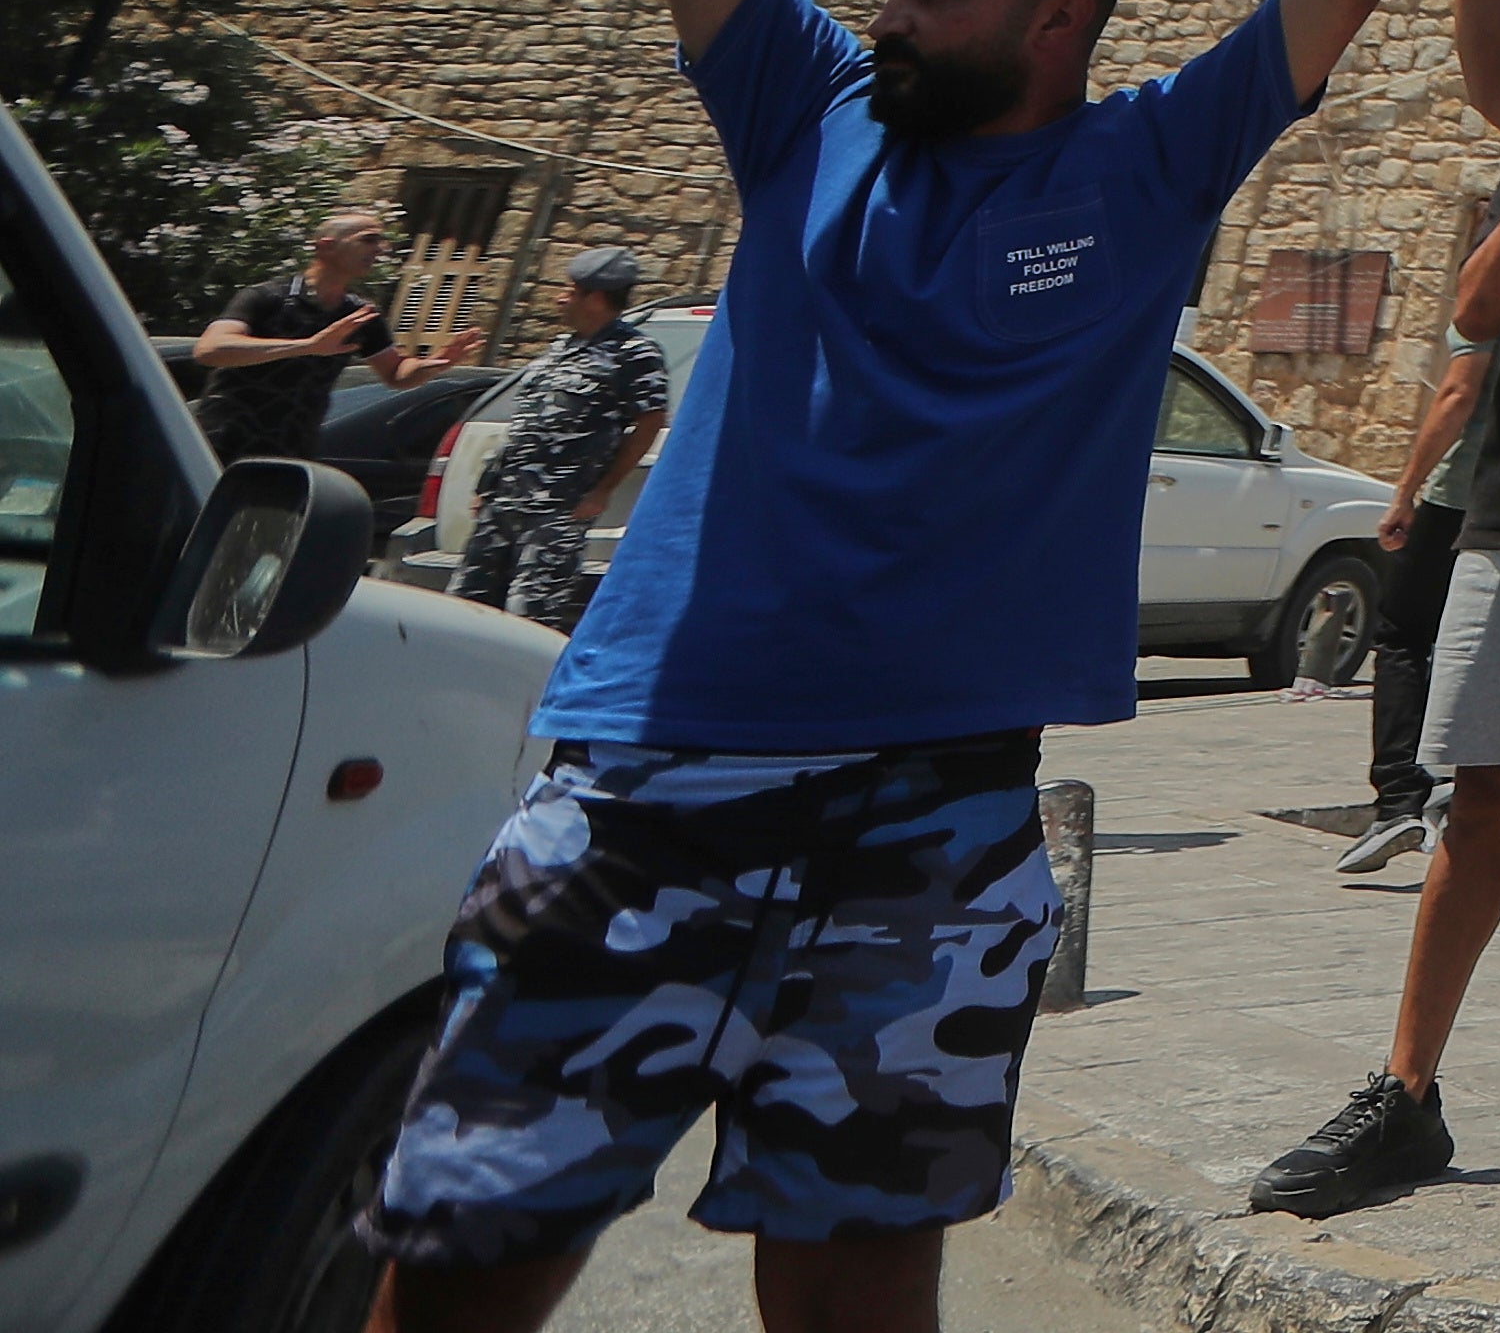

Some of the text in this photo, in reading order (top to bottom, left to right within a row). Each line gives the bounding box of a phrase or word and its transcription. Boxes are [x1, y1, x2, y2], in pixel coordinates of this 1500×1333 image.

[1006, 247, 1045, 263] STILL
[1023, 255, 1079, 276] FOLLOW
[1009, 273, 1074, 296] FREEDOM
